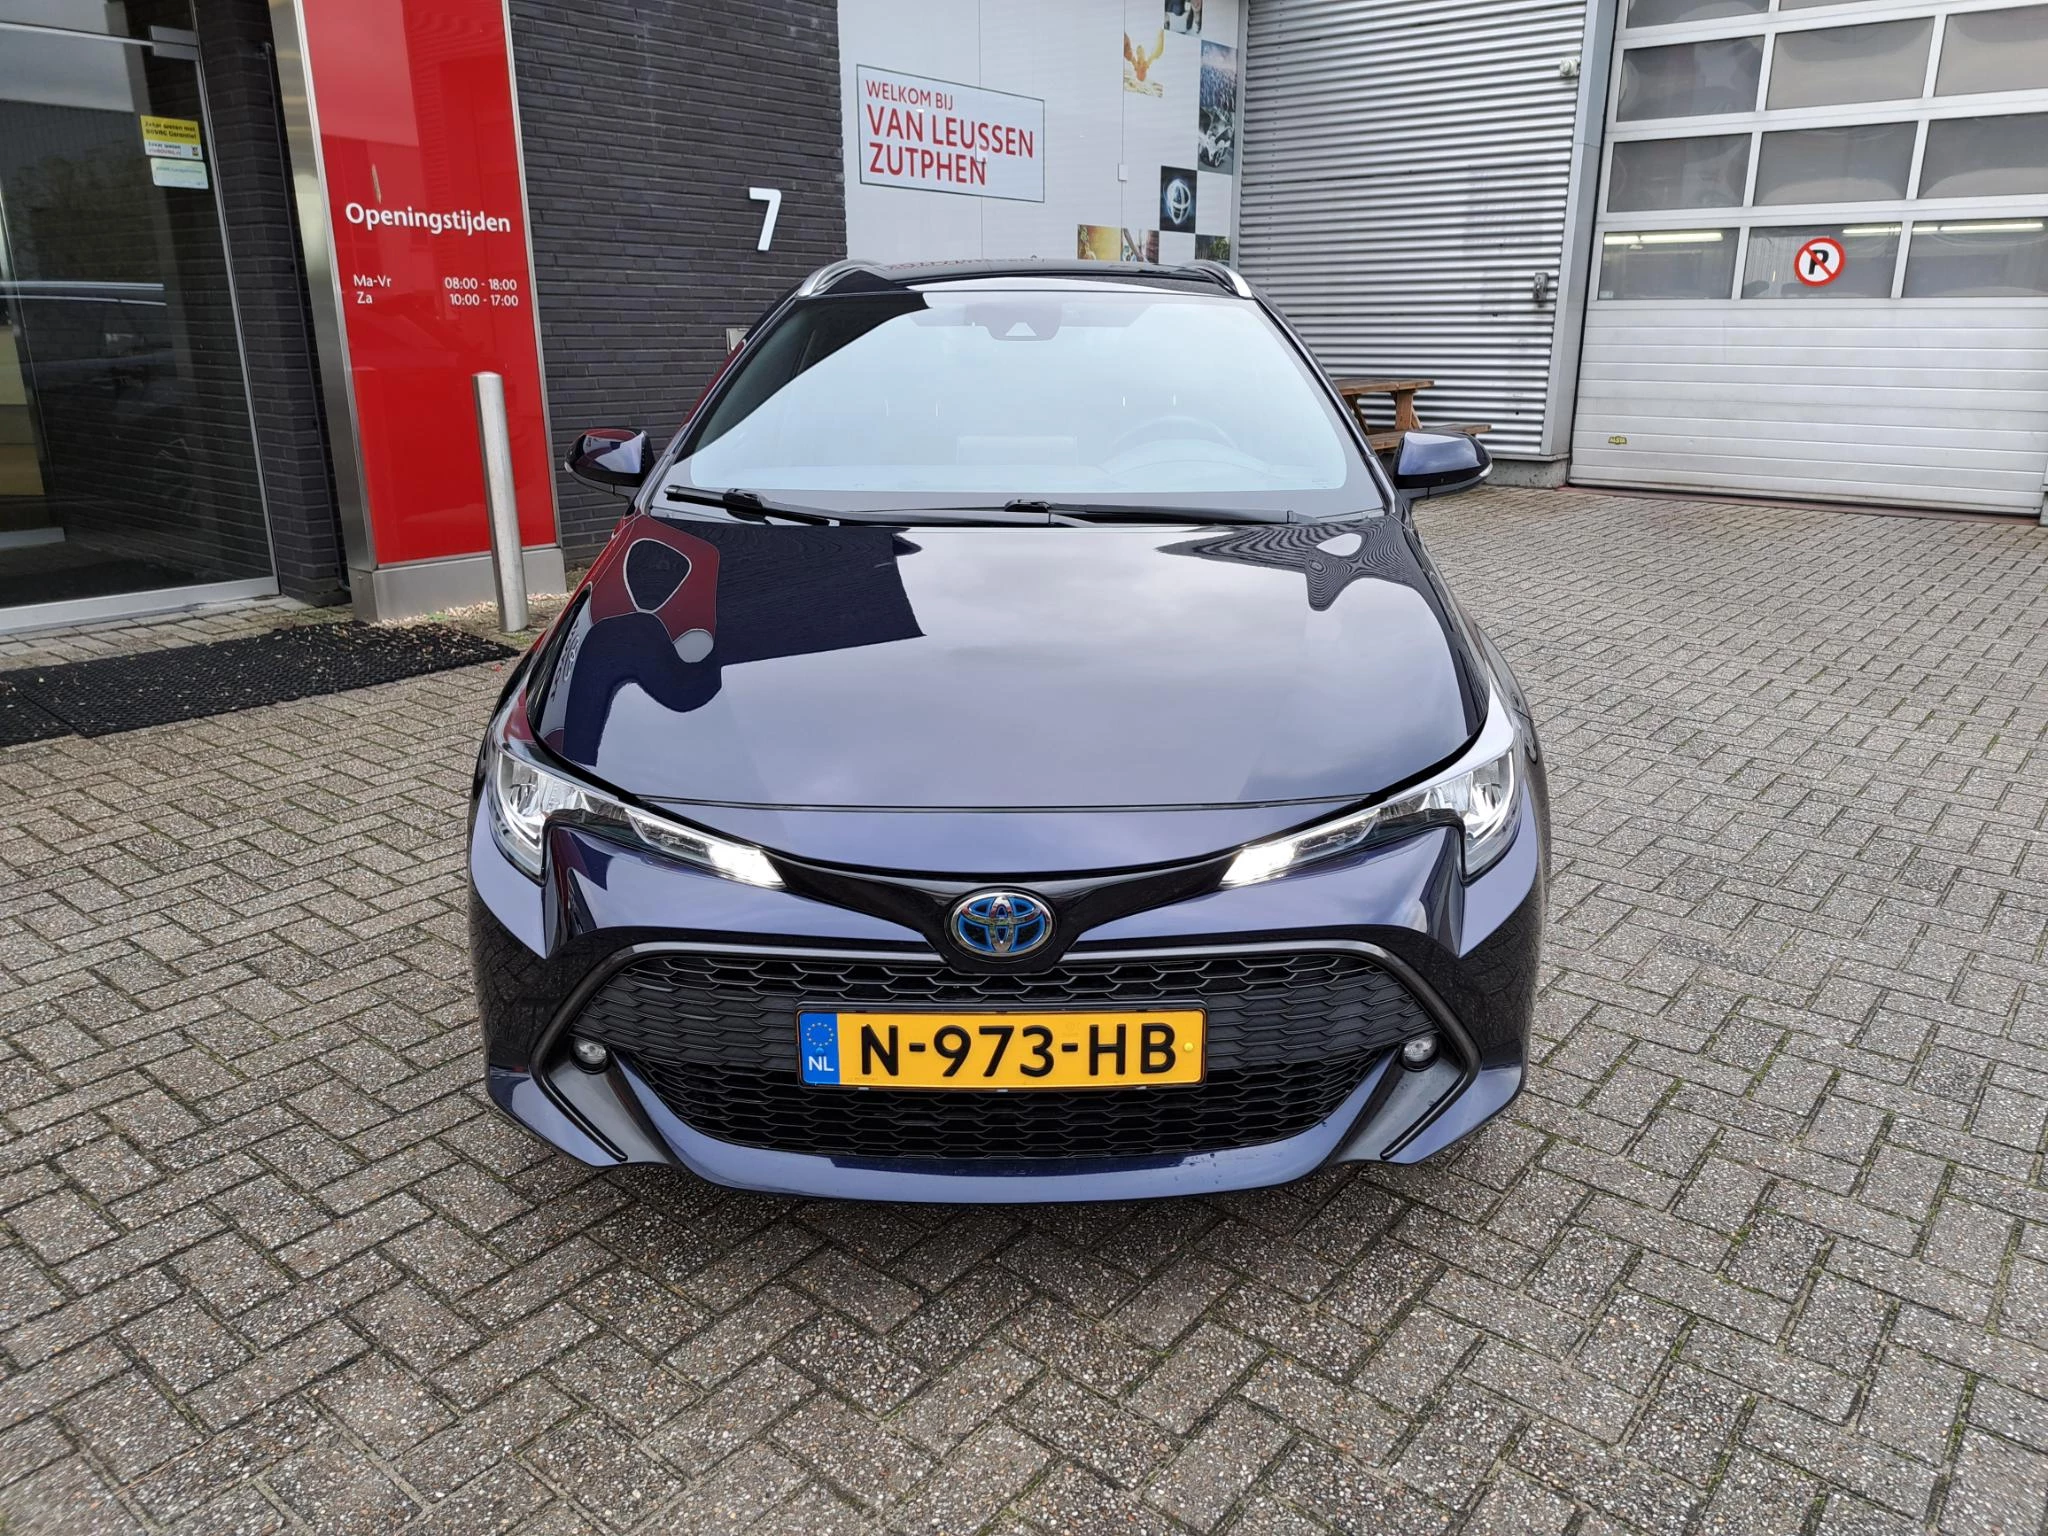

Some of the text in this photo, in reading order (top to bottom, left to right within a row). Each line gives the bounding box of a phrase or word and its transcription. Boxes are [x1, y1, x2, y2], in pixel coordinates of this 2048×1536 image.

[866, 79, 954, 111] WELKOM BIJ
[867, 103, 1034, 159] VAN LEUSSEN
[869, 142, 987, 186] ZUTPHEN
[345, 202, 511, 236] Openingstijden
[749, 187, 782, 251] 7
[353, 274, 392, 288] Ma-Vr
[444, 277, 478, 290] 08:00
[488, 278, 517, 291] 18:00
[357, 291, 373, 304] Za
[450, 293, 480, 306] 10:00
[491, 294, 519, 307] 17:00
[808, 1056, 834, 1072] NL
[861, 1023, 1176, 1078] N-973-HB
